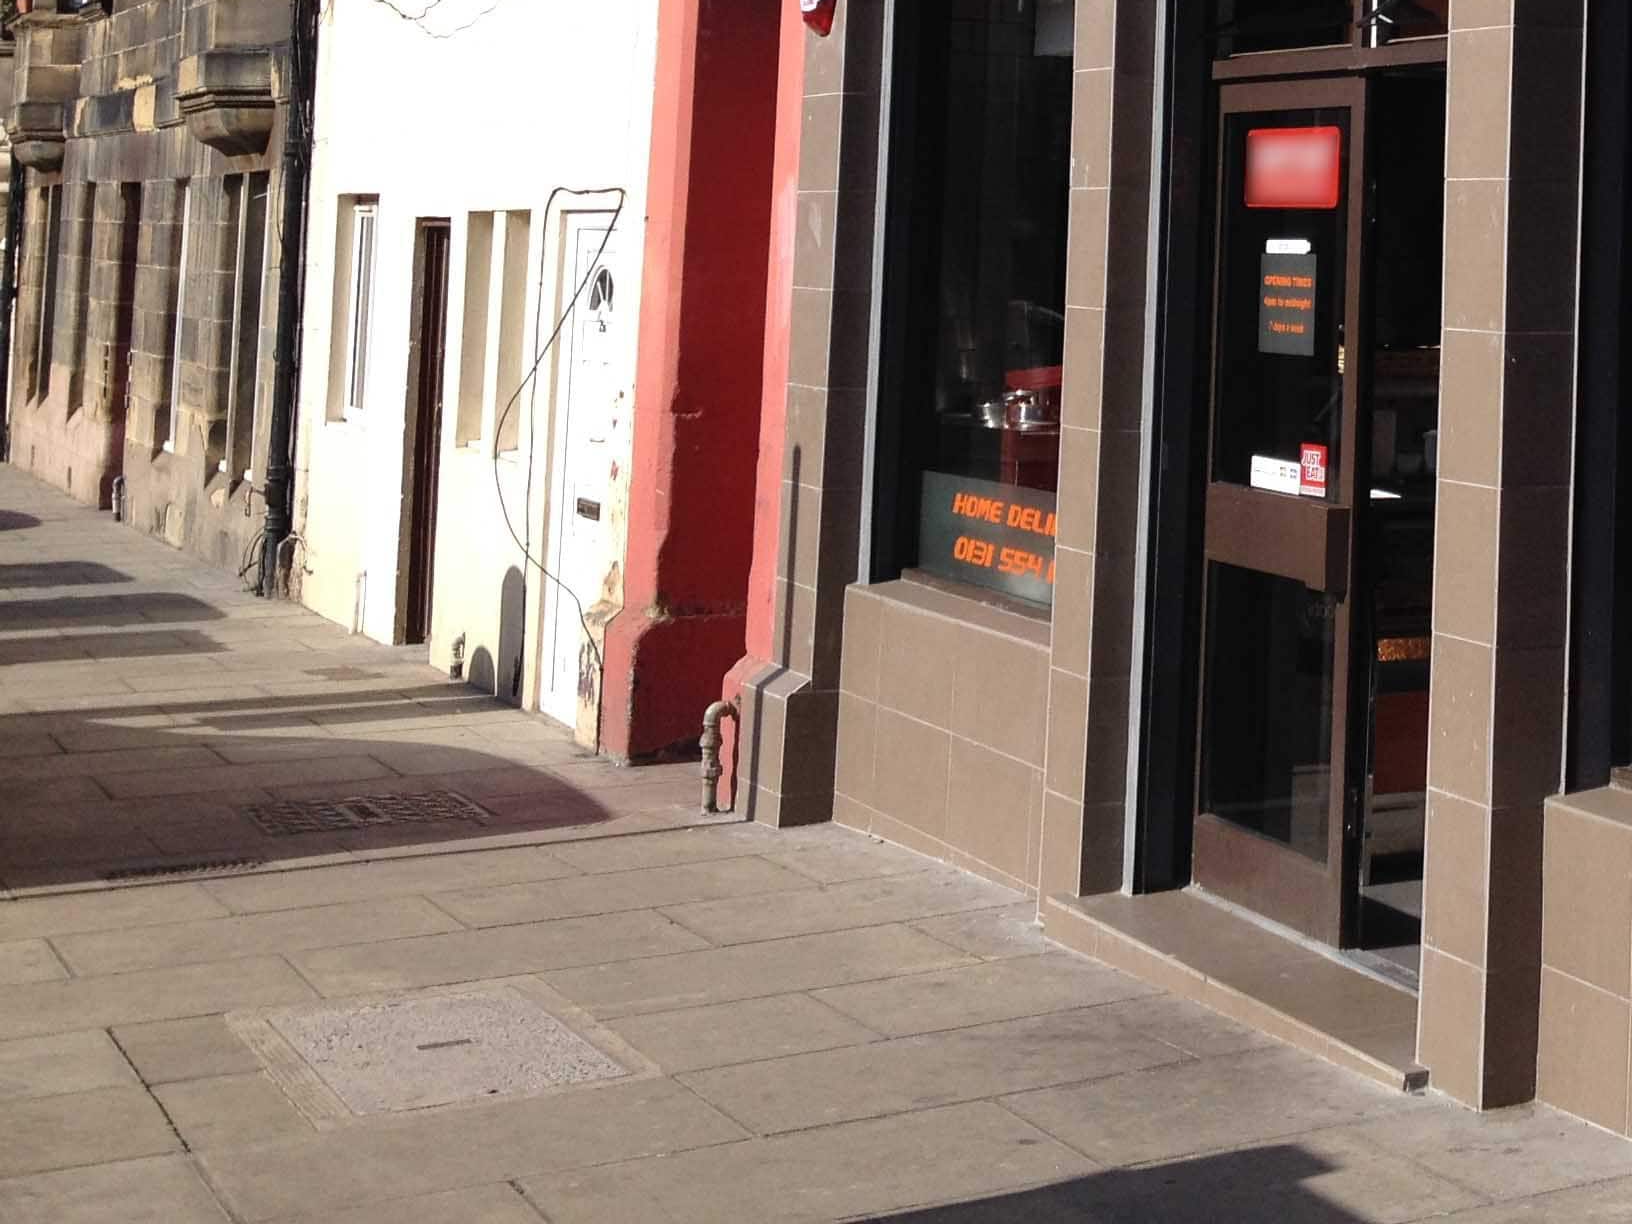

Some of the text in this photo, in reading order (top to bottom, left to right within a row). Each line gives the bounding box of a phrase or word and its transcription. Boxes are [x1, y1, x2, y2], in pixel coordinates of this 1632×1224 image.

[1302, 450, 1321, 466] JUST
[952, 492, 1004, 524] HOME
[953, 536, 995, 568] 0131
[998, 547, 1043, 579] 554
